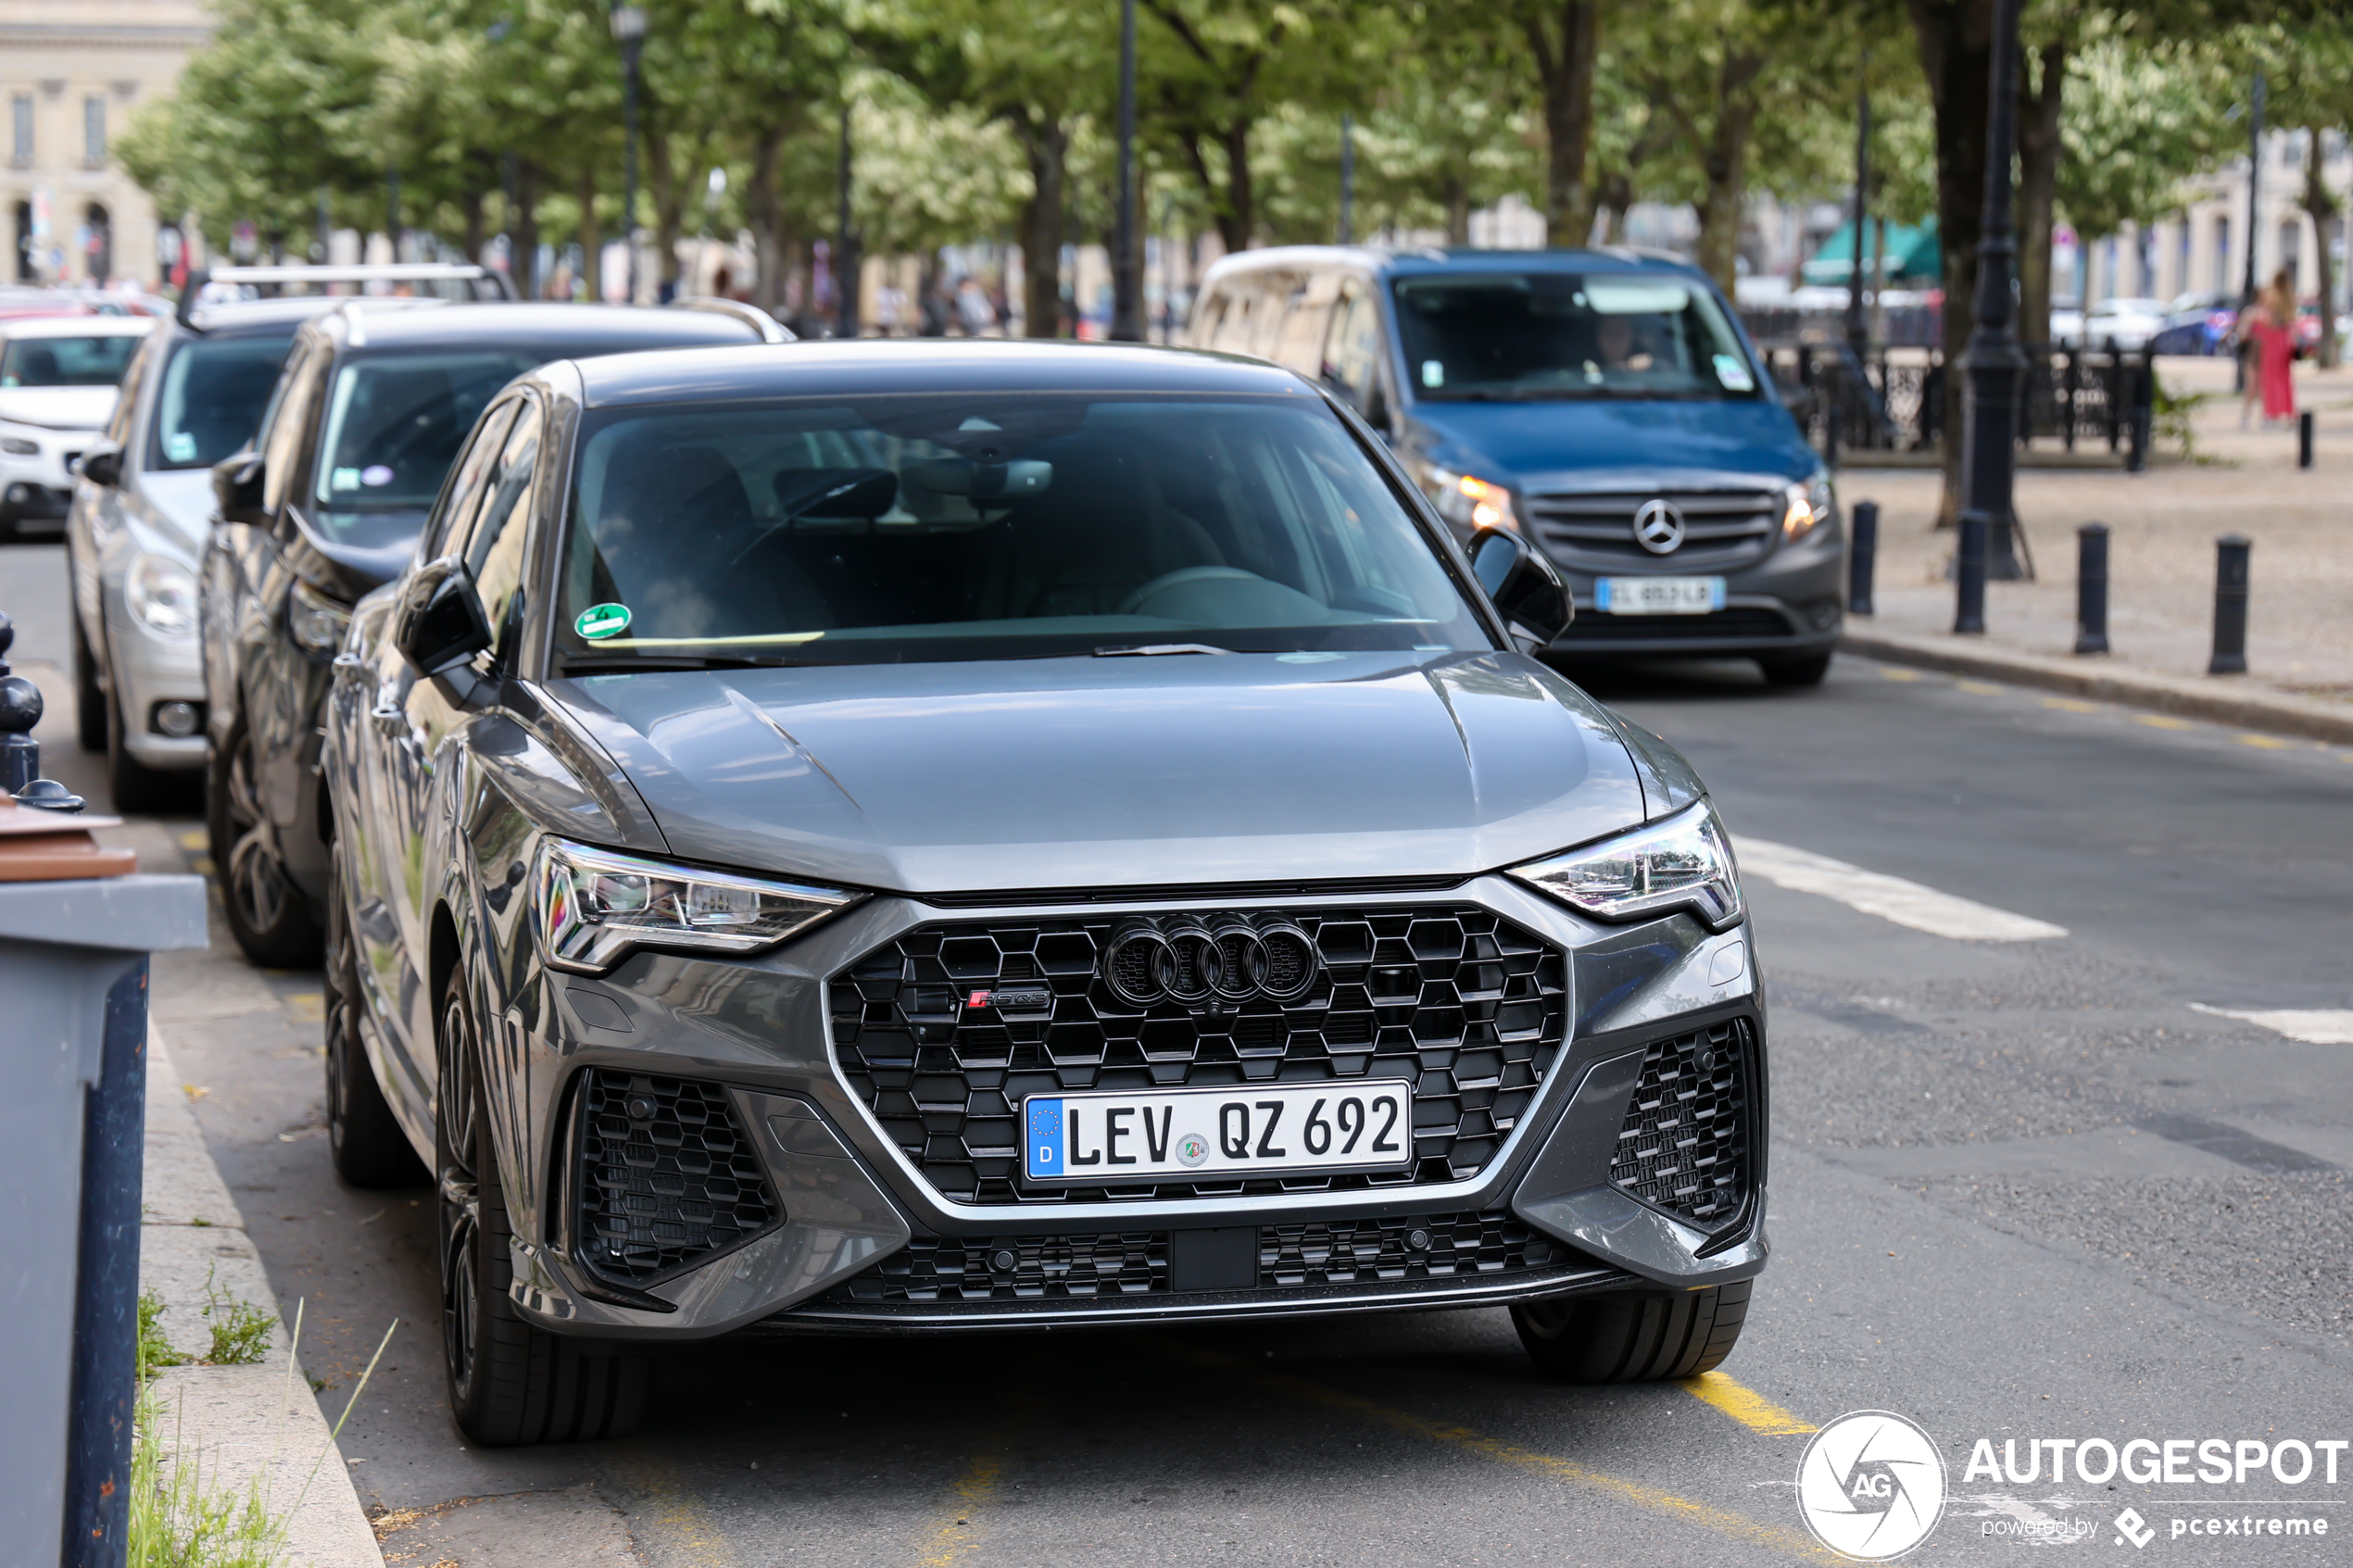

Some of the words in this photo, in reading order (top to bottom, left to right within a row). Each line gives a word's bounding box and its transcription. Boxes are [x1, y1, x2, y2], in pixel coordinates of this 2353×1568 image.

[1039, 1147, 1052, 1163] D
[1069, 1105, 1173, 1166] LEV
[1219, 1100, 1286, 1160] QZ
[1303, 1096, 1400, 1156] 692
